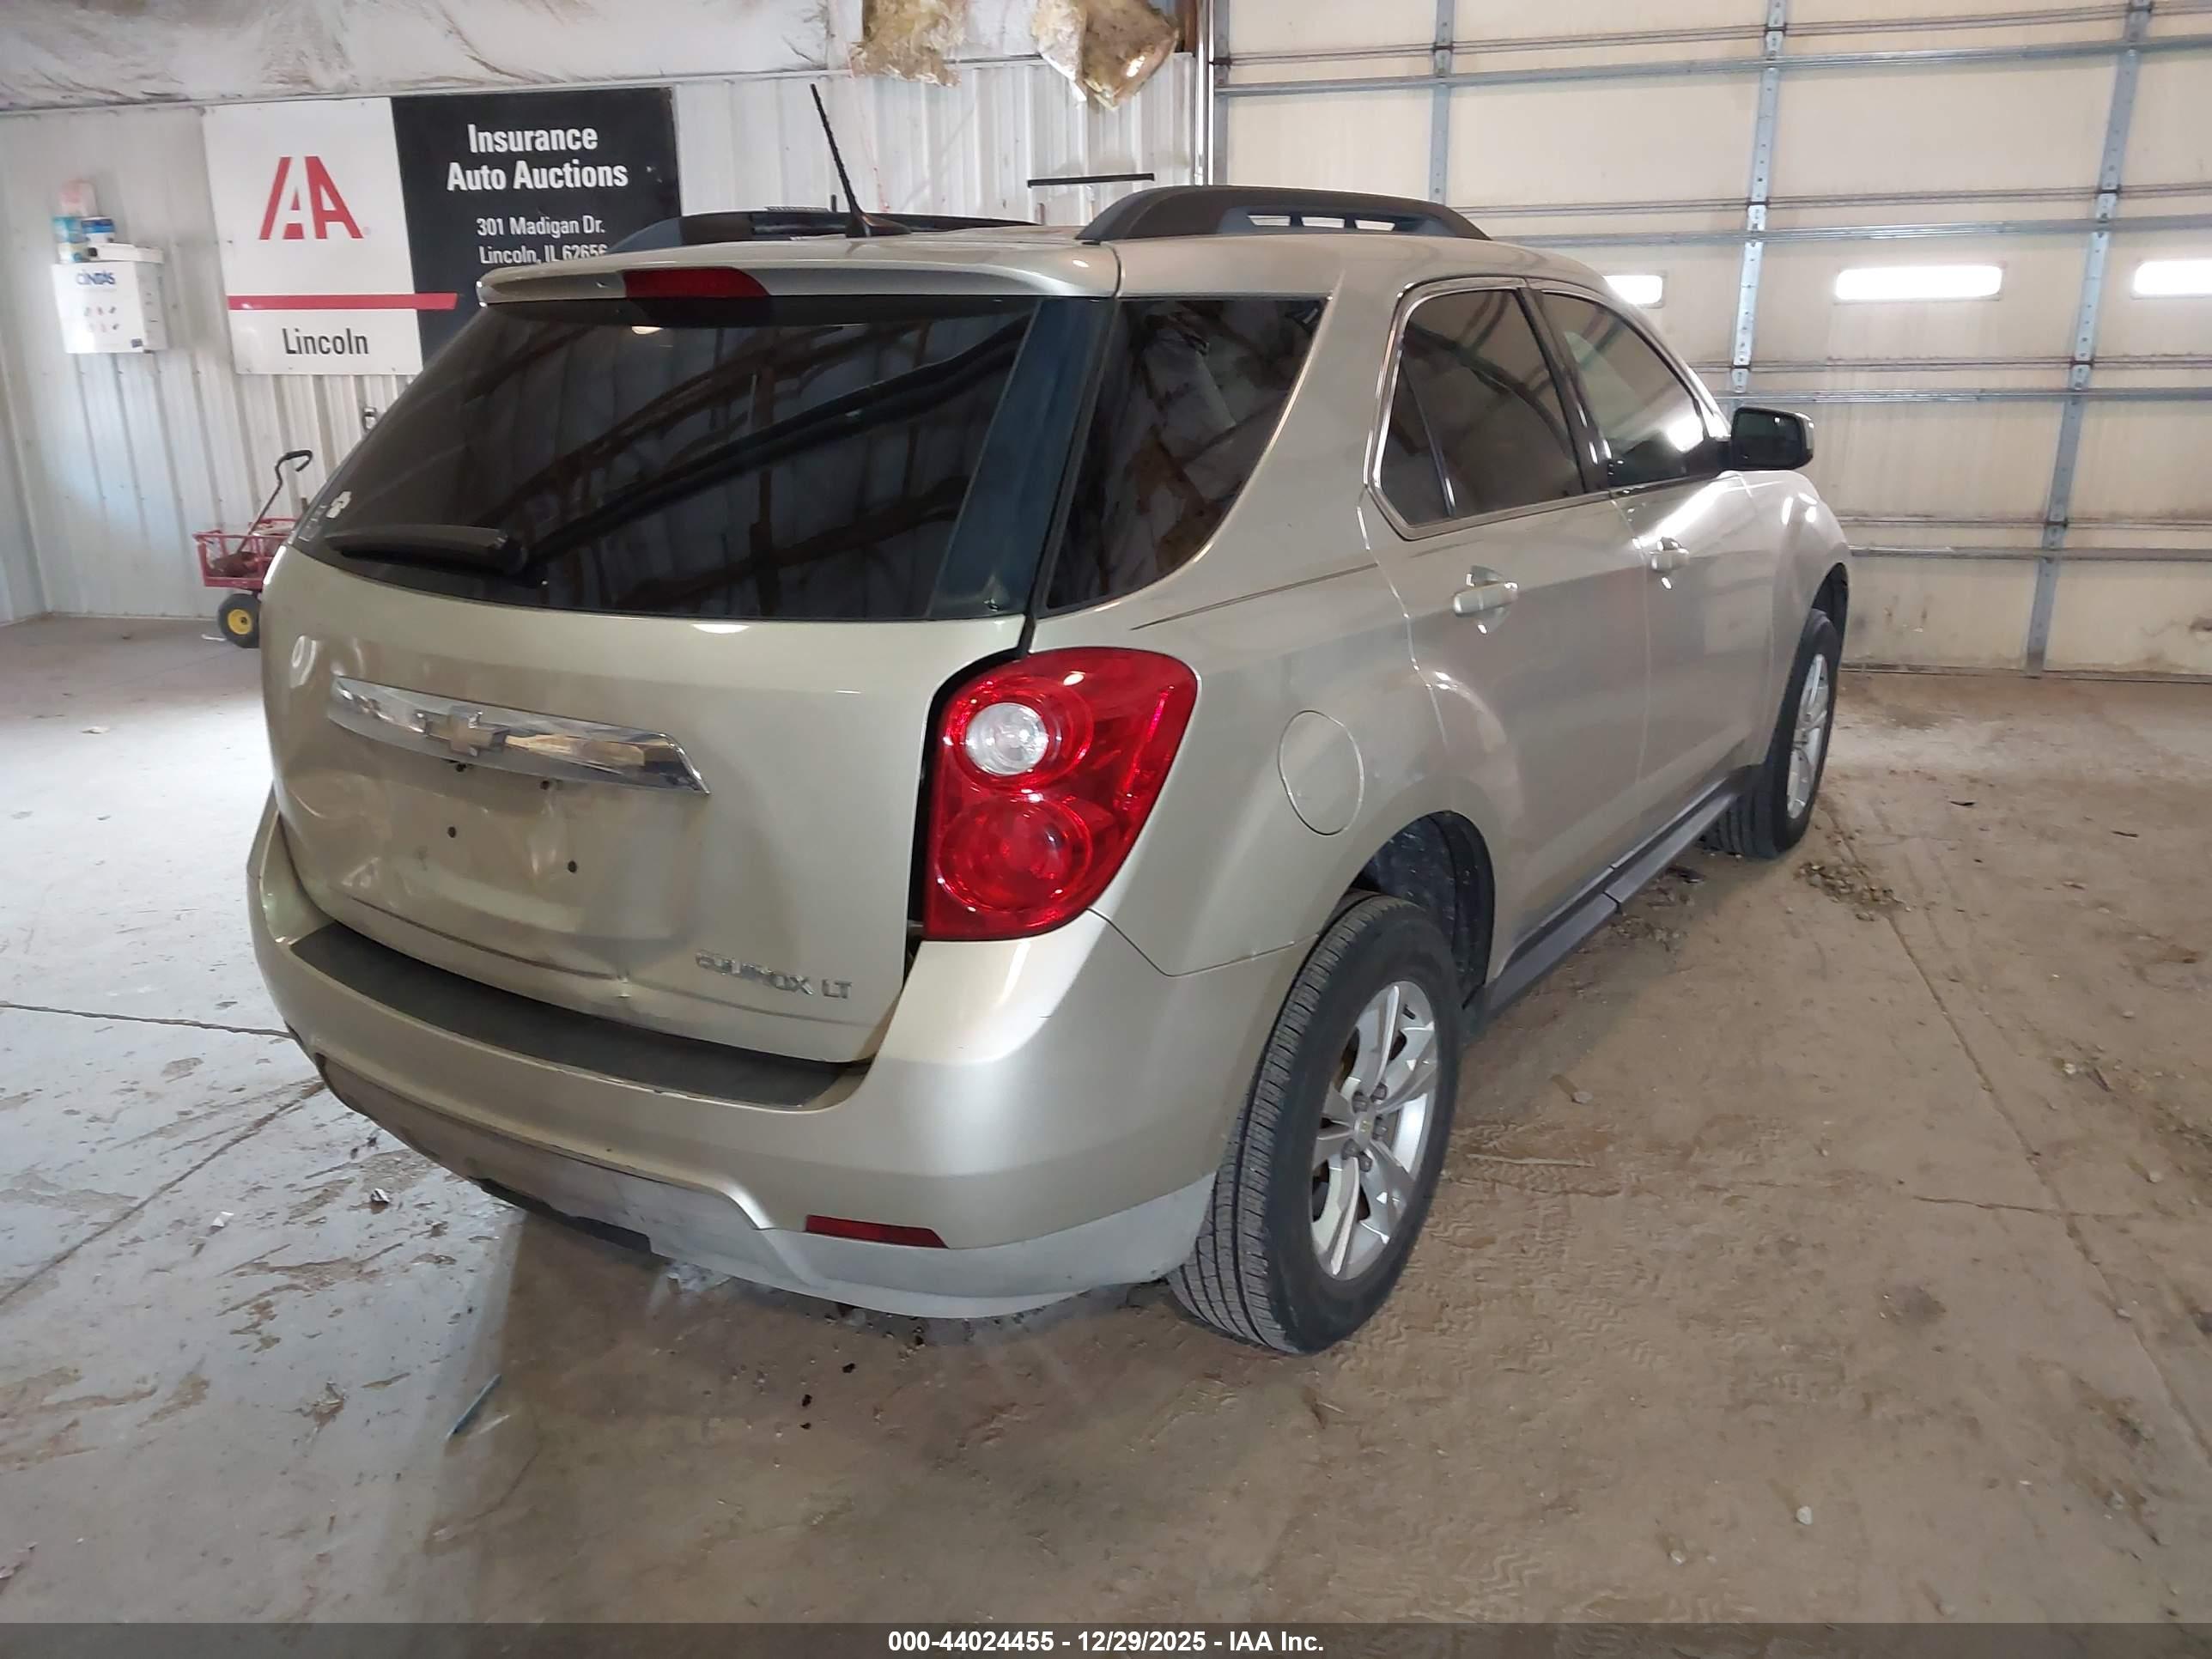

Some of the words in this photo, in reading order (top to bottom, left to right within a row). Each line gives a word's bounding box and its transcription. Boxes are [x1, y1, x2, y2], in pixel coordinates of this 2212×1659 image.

[467, 124, 599, 153] Insurance
[447, 161, 507, 191] Auto
[513, 158, 629, 189] Auctions
[476, 217, 504, 236] 301
[509, 216, 580, 239] Madigan
[582, 215, 605, 234] Dr.
[478, 245, 542, 264] Lincoln,
[544, 244, 560, 263] IL
[282, 327, 369, 355] Lincoln
[821, 978, 853, 1000] LT
